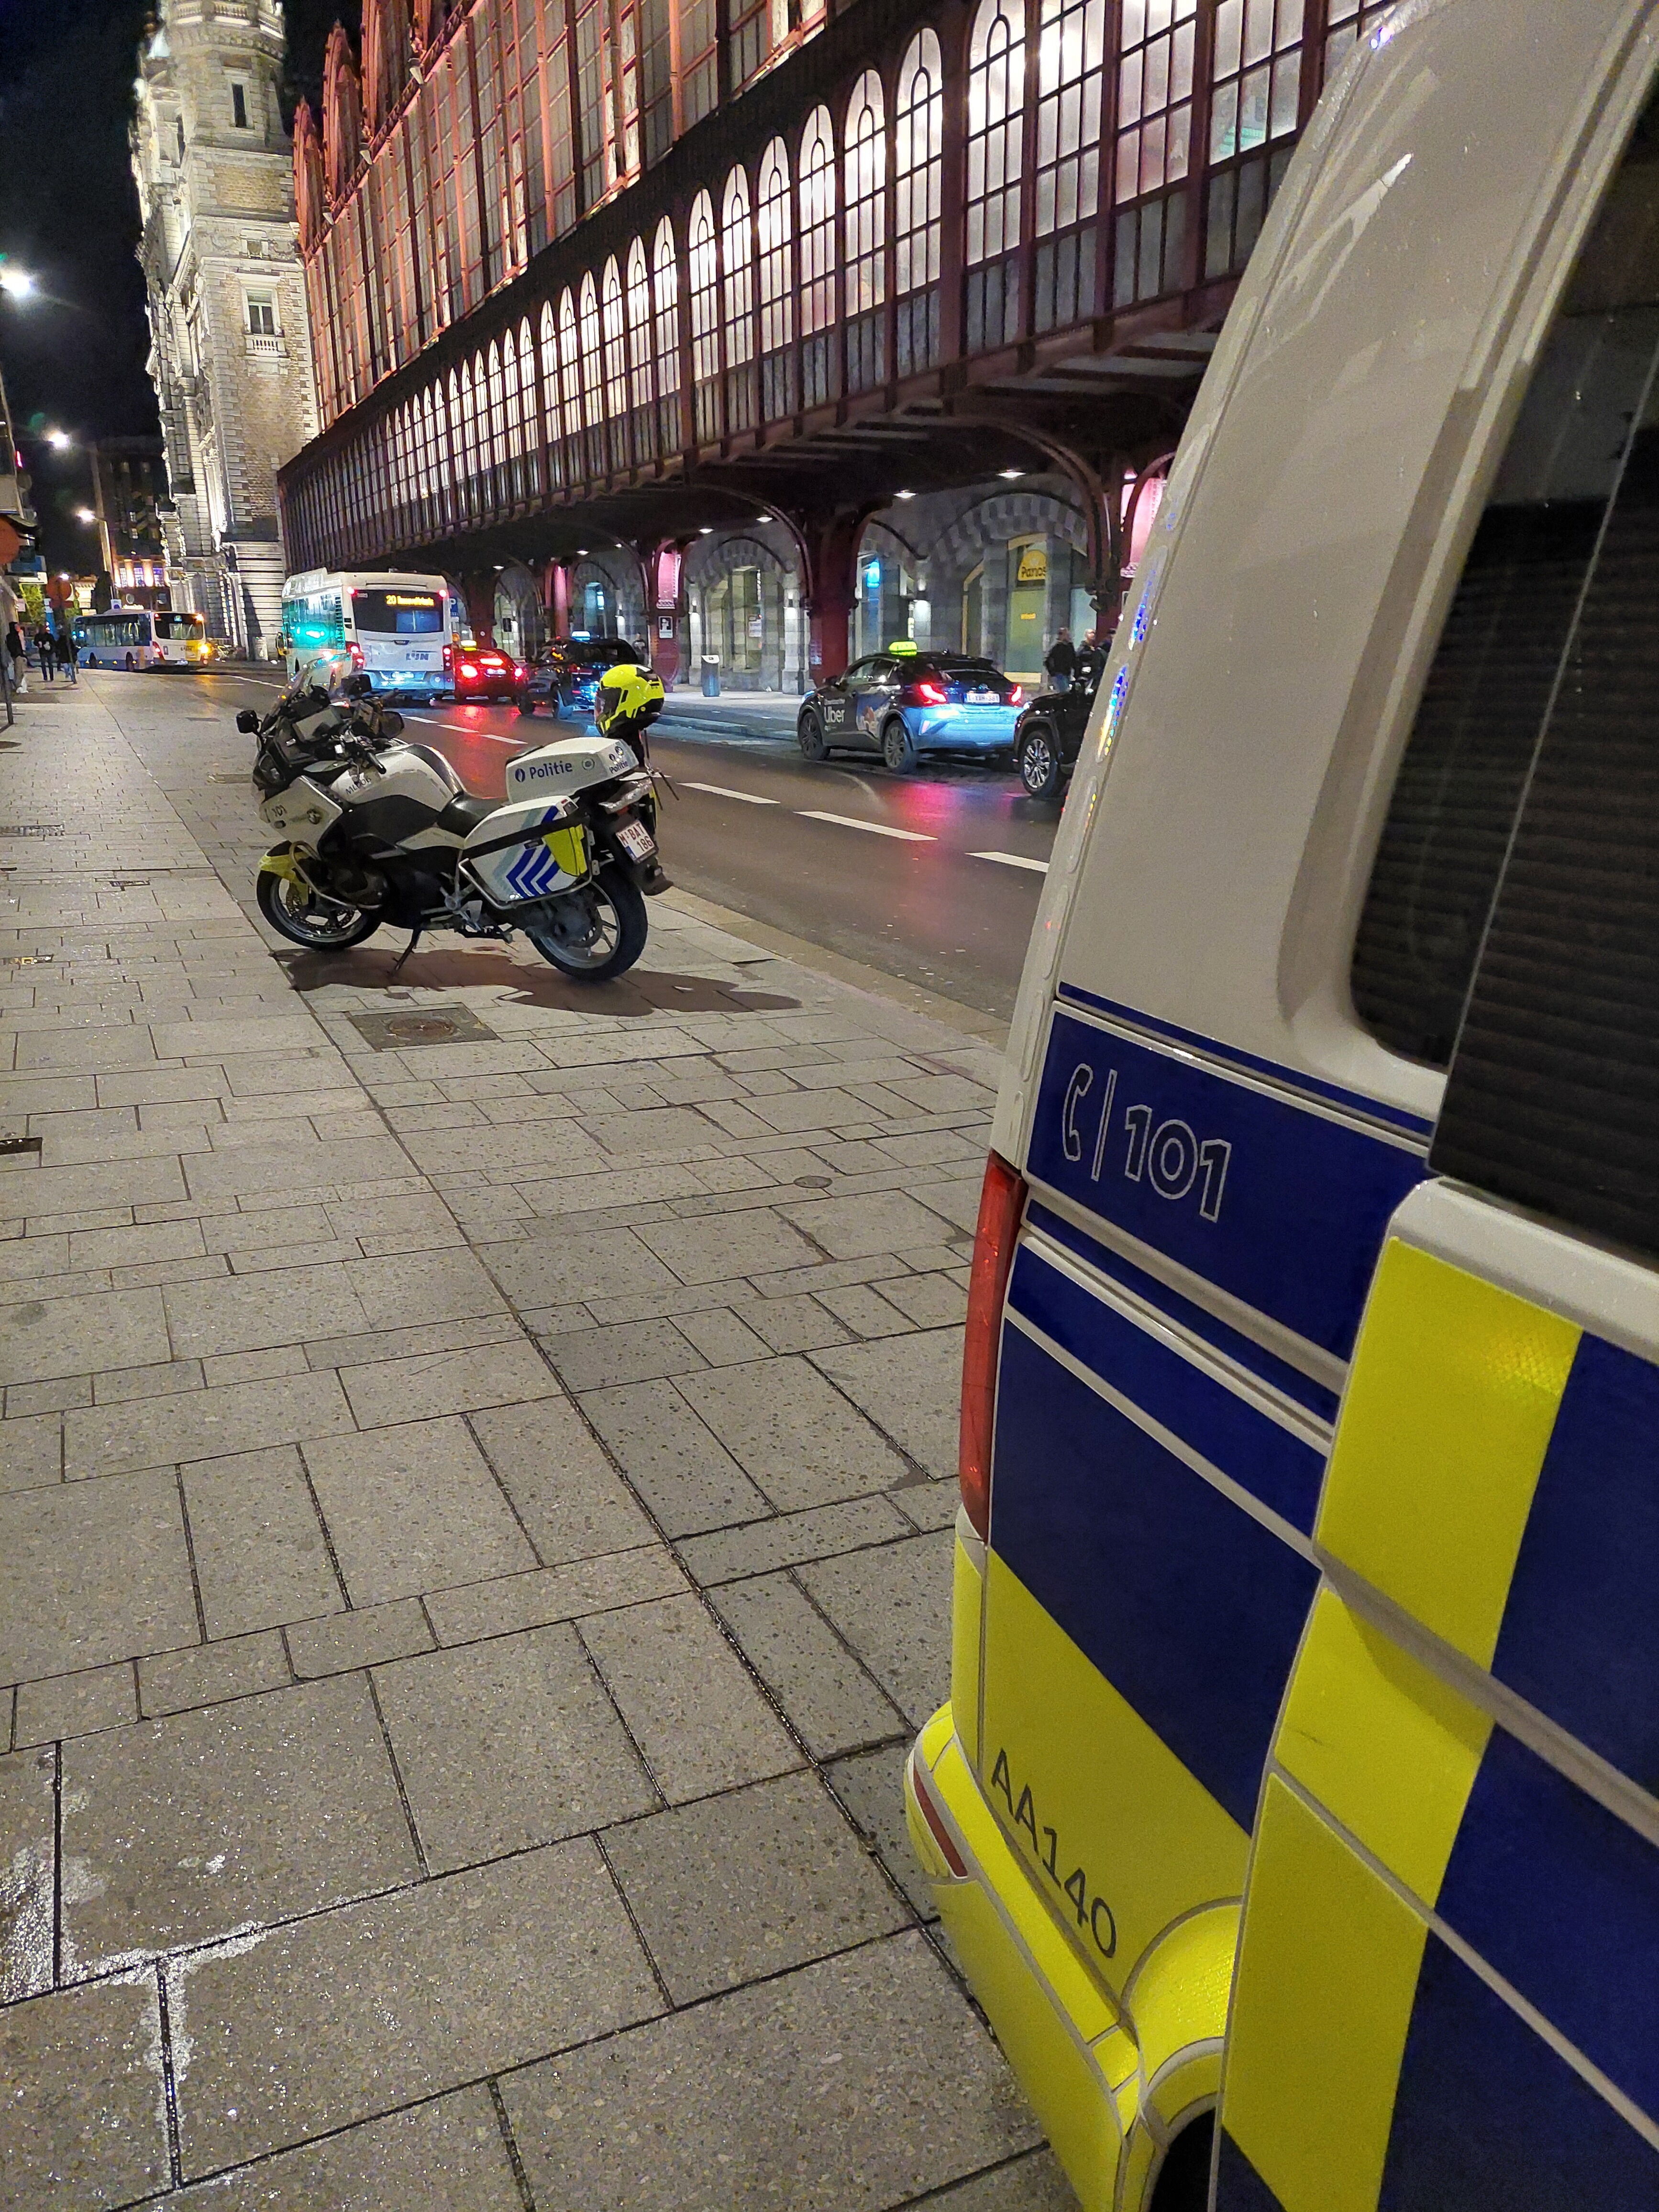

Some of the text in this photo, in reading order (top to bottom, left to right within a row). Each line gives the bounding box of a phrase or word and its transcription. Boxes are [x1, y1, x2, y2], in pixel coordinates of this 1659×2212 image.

[824, 706, 845, 723] Uber
[530, 761, 573, 779] Politie
[608, 761, 629, 774] Politie
[636, 836, 653, 852] 186
[1125, 1104, 1232, 1223] 101
[991, 1747, 1117, 1958] AA140
